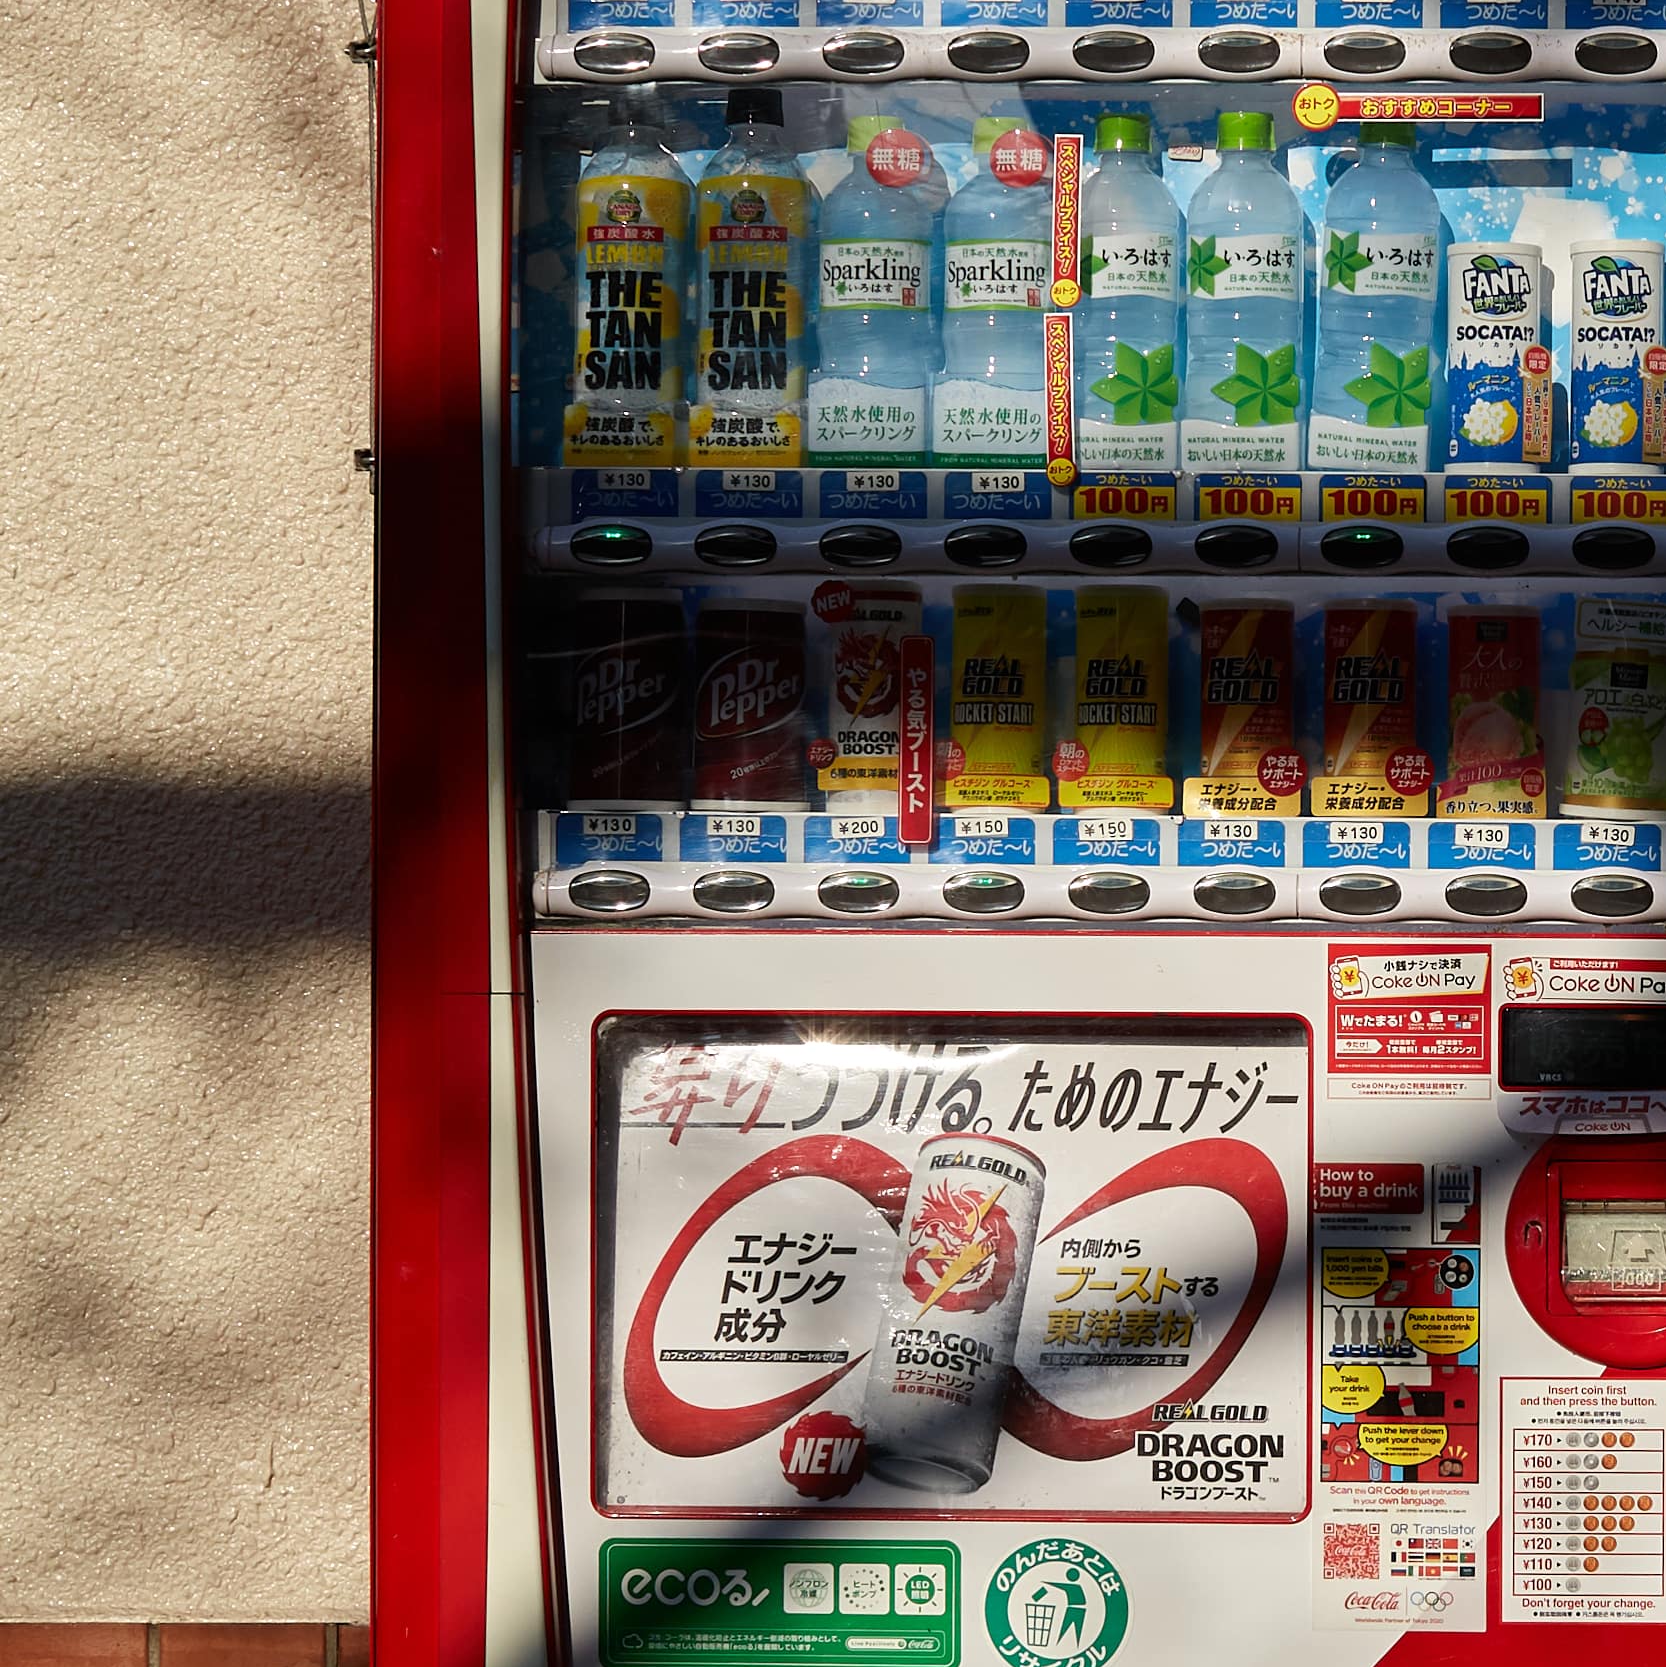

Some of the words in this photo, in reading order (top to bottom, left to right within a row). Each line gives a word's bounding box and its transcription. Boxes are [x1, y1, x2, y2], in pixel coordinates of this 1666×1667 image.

[1361, 98, 1512, 116] おすすめコーナー
[871, 147, 921, 171] 無糖
[994, 146, 1044, 172] 無糖
[823, 258, 921, 287] Sparkling
[947, 256, 1046, 286] Sparkling
[586, 271, 663, 309] THE
[709, 271, 786, 309] THE
[586, 310, 662, 348] TAN
[709, 310, 786, 348] TAN
[1456, 326, 1534, 343] SOCATA!?
[585, 350, 662, 390] SAN
[708, 350, 786, 390] SAN
[817, 405, 916, 423] 天然水使用の
[816, 426, 916, 442] スパークリング
[1316, 445, 1418, 465] おいしい日本の天然水
[1327, 489, 1417, 517] 100円
[816, 590, 852, 613] NEW
[744, 656, 778, 693] Dr
[1210, 648, 1277, 680] REAL
[710, 672, 799, 721] Pepper
[1208, 682, 1278, 704] GOLD
[906, 666, 928, 813] やる気ブースト
[1198, 797, 1278, 811] 栄養成分配合
[838, 820, 879, 834] ¥200
[960, 820, 1004, 834] ¥150
[1384, 959, 1461, 971] 小銭ナシで決済
[1549, 974, 1601, 993] Coke
[1605, 971, 1634, 993] ON
[1009, 1059, 1300, 1132] ためのエナジー
[1320, 1169, 1354, 1181] How
[1358, 1170, 1374, 1181] to
[1320, 1184, 1353, 1199] buy
[1358, 1187, 1368, 1198] a
[1373, 1184, 1418, 1198] drink
[733, 1232, 859, 1263] エナジー
[1060, 1238, 1142, 1260] 内側から
[720, 1274, 847, 1305] ドリンク
[1054, 1265, 1220, 1303] ブーストする
[714, 1308, 787, 1344] 成分
[1041, 1309, 1196, 1348] 東洋素材
[891, 1328, 995, 1366] DRAGON
[895, 1348, 981, 1377] BOOST
[893, 1369, 975, 1392] エナジードリンク
[1548, 1386, 1578, 1395] Insert
[1581, 1386, 1603, 1395] coin
[1606, 1386, 1626, 1395] first
[1136, 1433, 1284, 1460] DRAGON
[1523, 1434, 1552, 1446] ¥170
[787, 1437, 860, 1476] NEW
[1151, 1460, 1264, 1484] BOOST
[1160, 1485, 1259, 1501] ドラゴンブースト
[1391, 1524, 1409, 1534] QR
[1415, 1524, 1475, 1535] Translator
[1523, 1538, 1552, 1549] ¥120
[995, 1540, 1122, 1597] のんだあとは
[1523, 1559, 1552, 1570] ¥110
[910, 1580, 931, 1590] LED
[1523, 1579, 1552, 1590] ¥100
[1345, 1591, 1402, 1611] Coca-Cola
[1522, 1599, 1550, 1608] Don't
[1553, 1599, 1584, 1610] forget
[1587, 1600, 1610, 1610] your
[1613, 1599, 1655, 1610] change.
